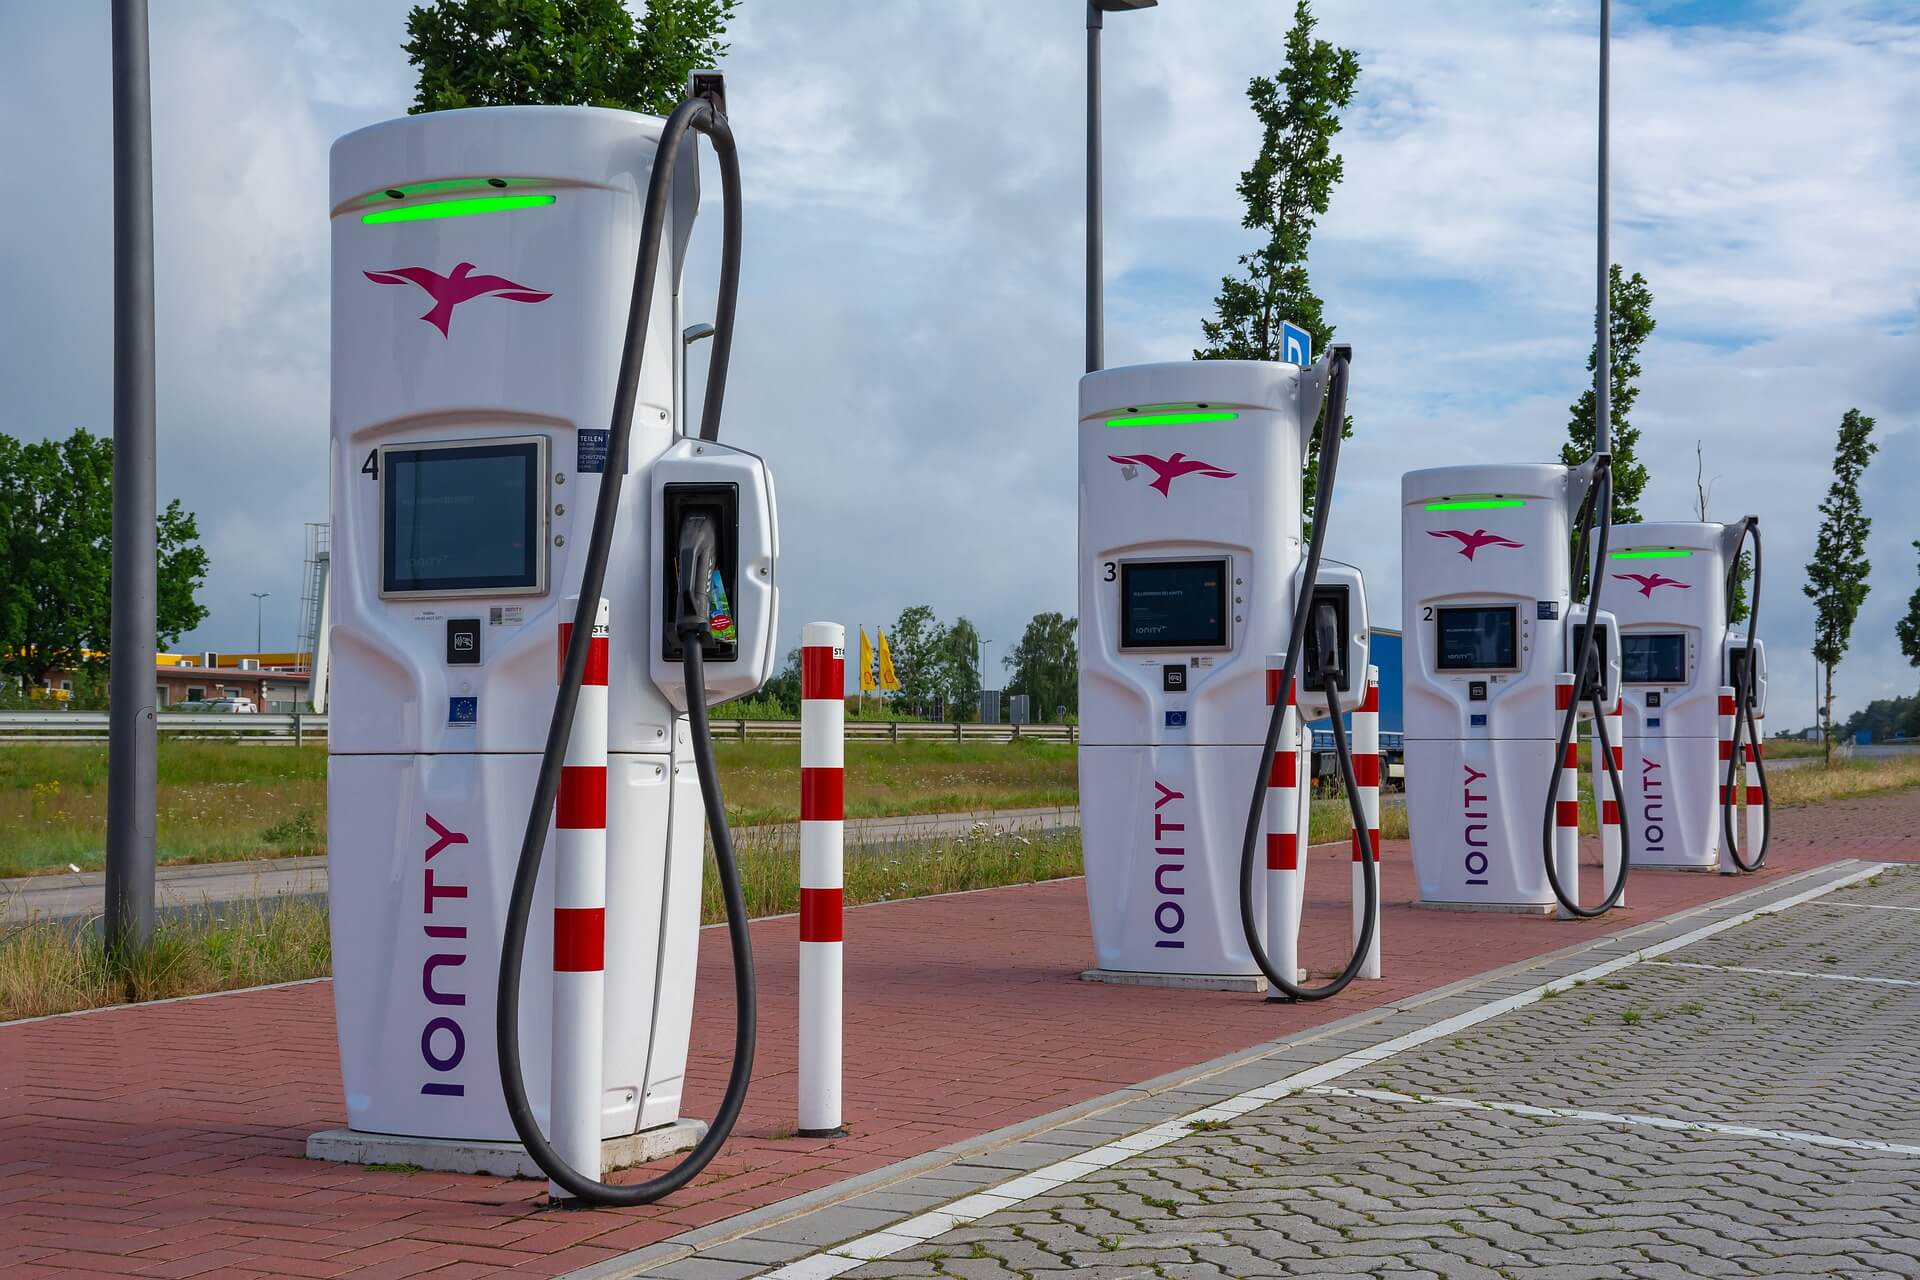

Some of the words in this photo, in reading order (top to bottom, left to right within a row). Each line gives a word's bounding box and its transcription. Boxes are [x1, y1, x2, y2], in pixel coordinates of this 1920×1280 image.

[361, 448, 379, 481] 4
[1103, 561, 1117, 582] 3
[1423, 606, 1433, 621] 2
[1463, 764, 1489, 886] IONITY
[1641, 757, 1665, 852] IONITY
[1154, 780, 1185, 948] IONITY
[420, 812, 469, 1097] IONITY
